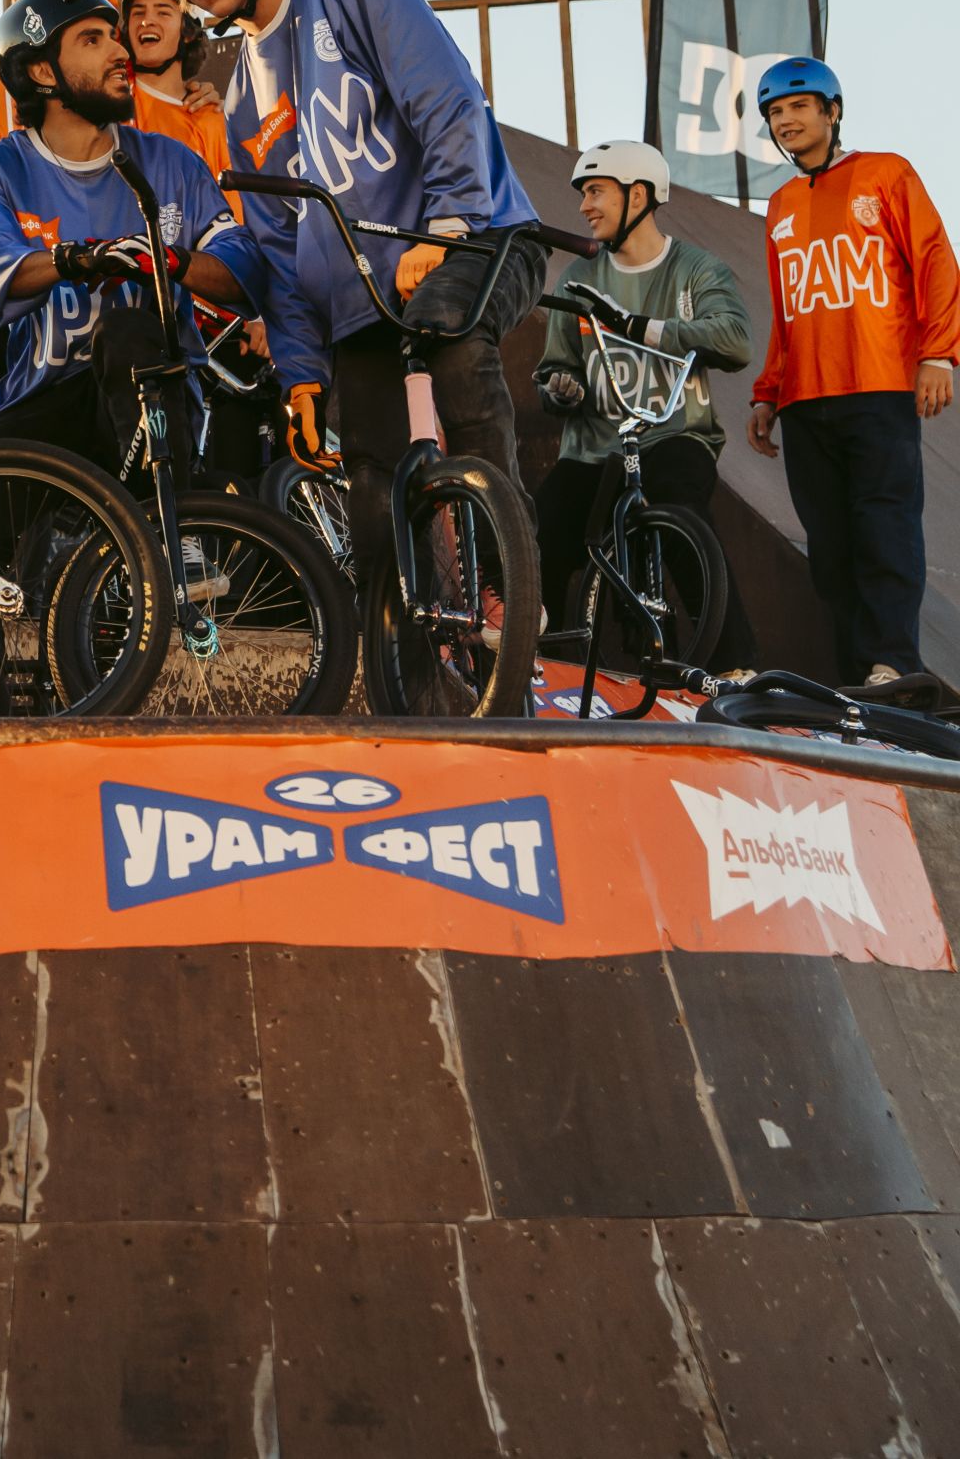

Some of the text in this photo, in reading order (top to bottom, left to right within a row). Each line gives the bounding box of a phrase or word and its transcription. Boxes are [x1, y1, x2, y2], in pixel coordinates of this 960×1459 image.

[270, 109, 291, 131] Банк
[357, 220, 398, 234] REDBMX
[778, 234, 889, 322] РАМ
[139, 582, 153, 652] MAXXIS
[274, 777, 392, 805] 26
[115, 803, 542, 896] УРАМ ФЕСТ
[722, 828, 851, 878] Альфа Банк
